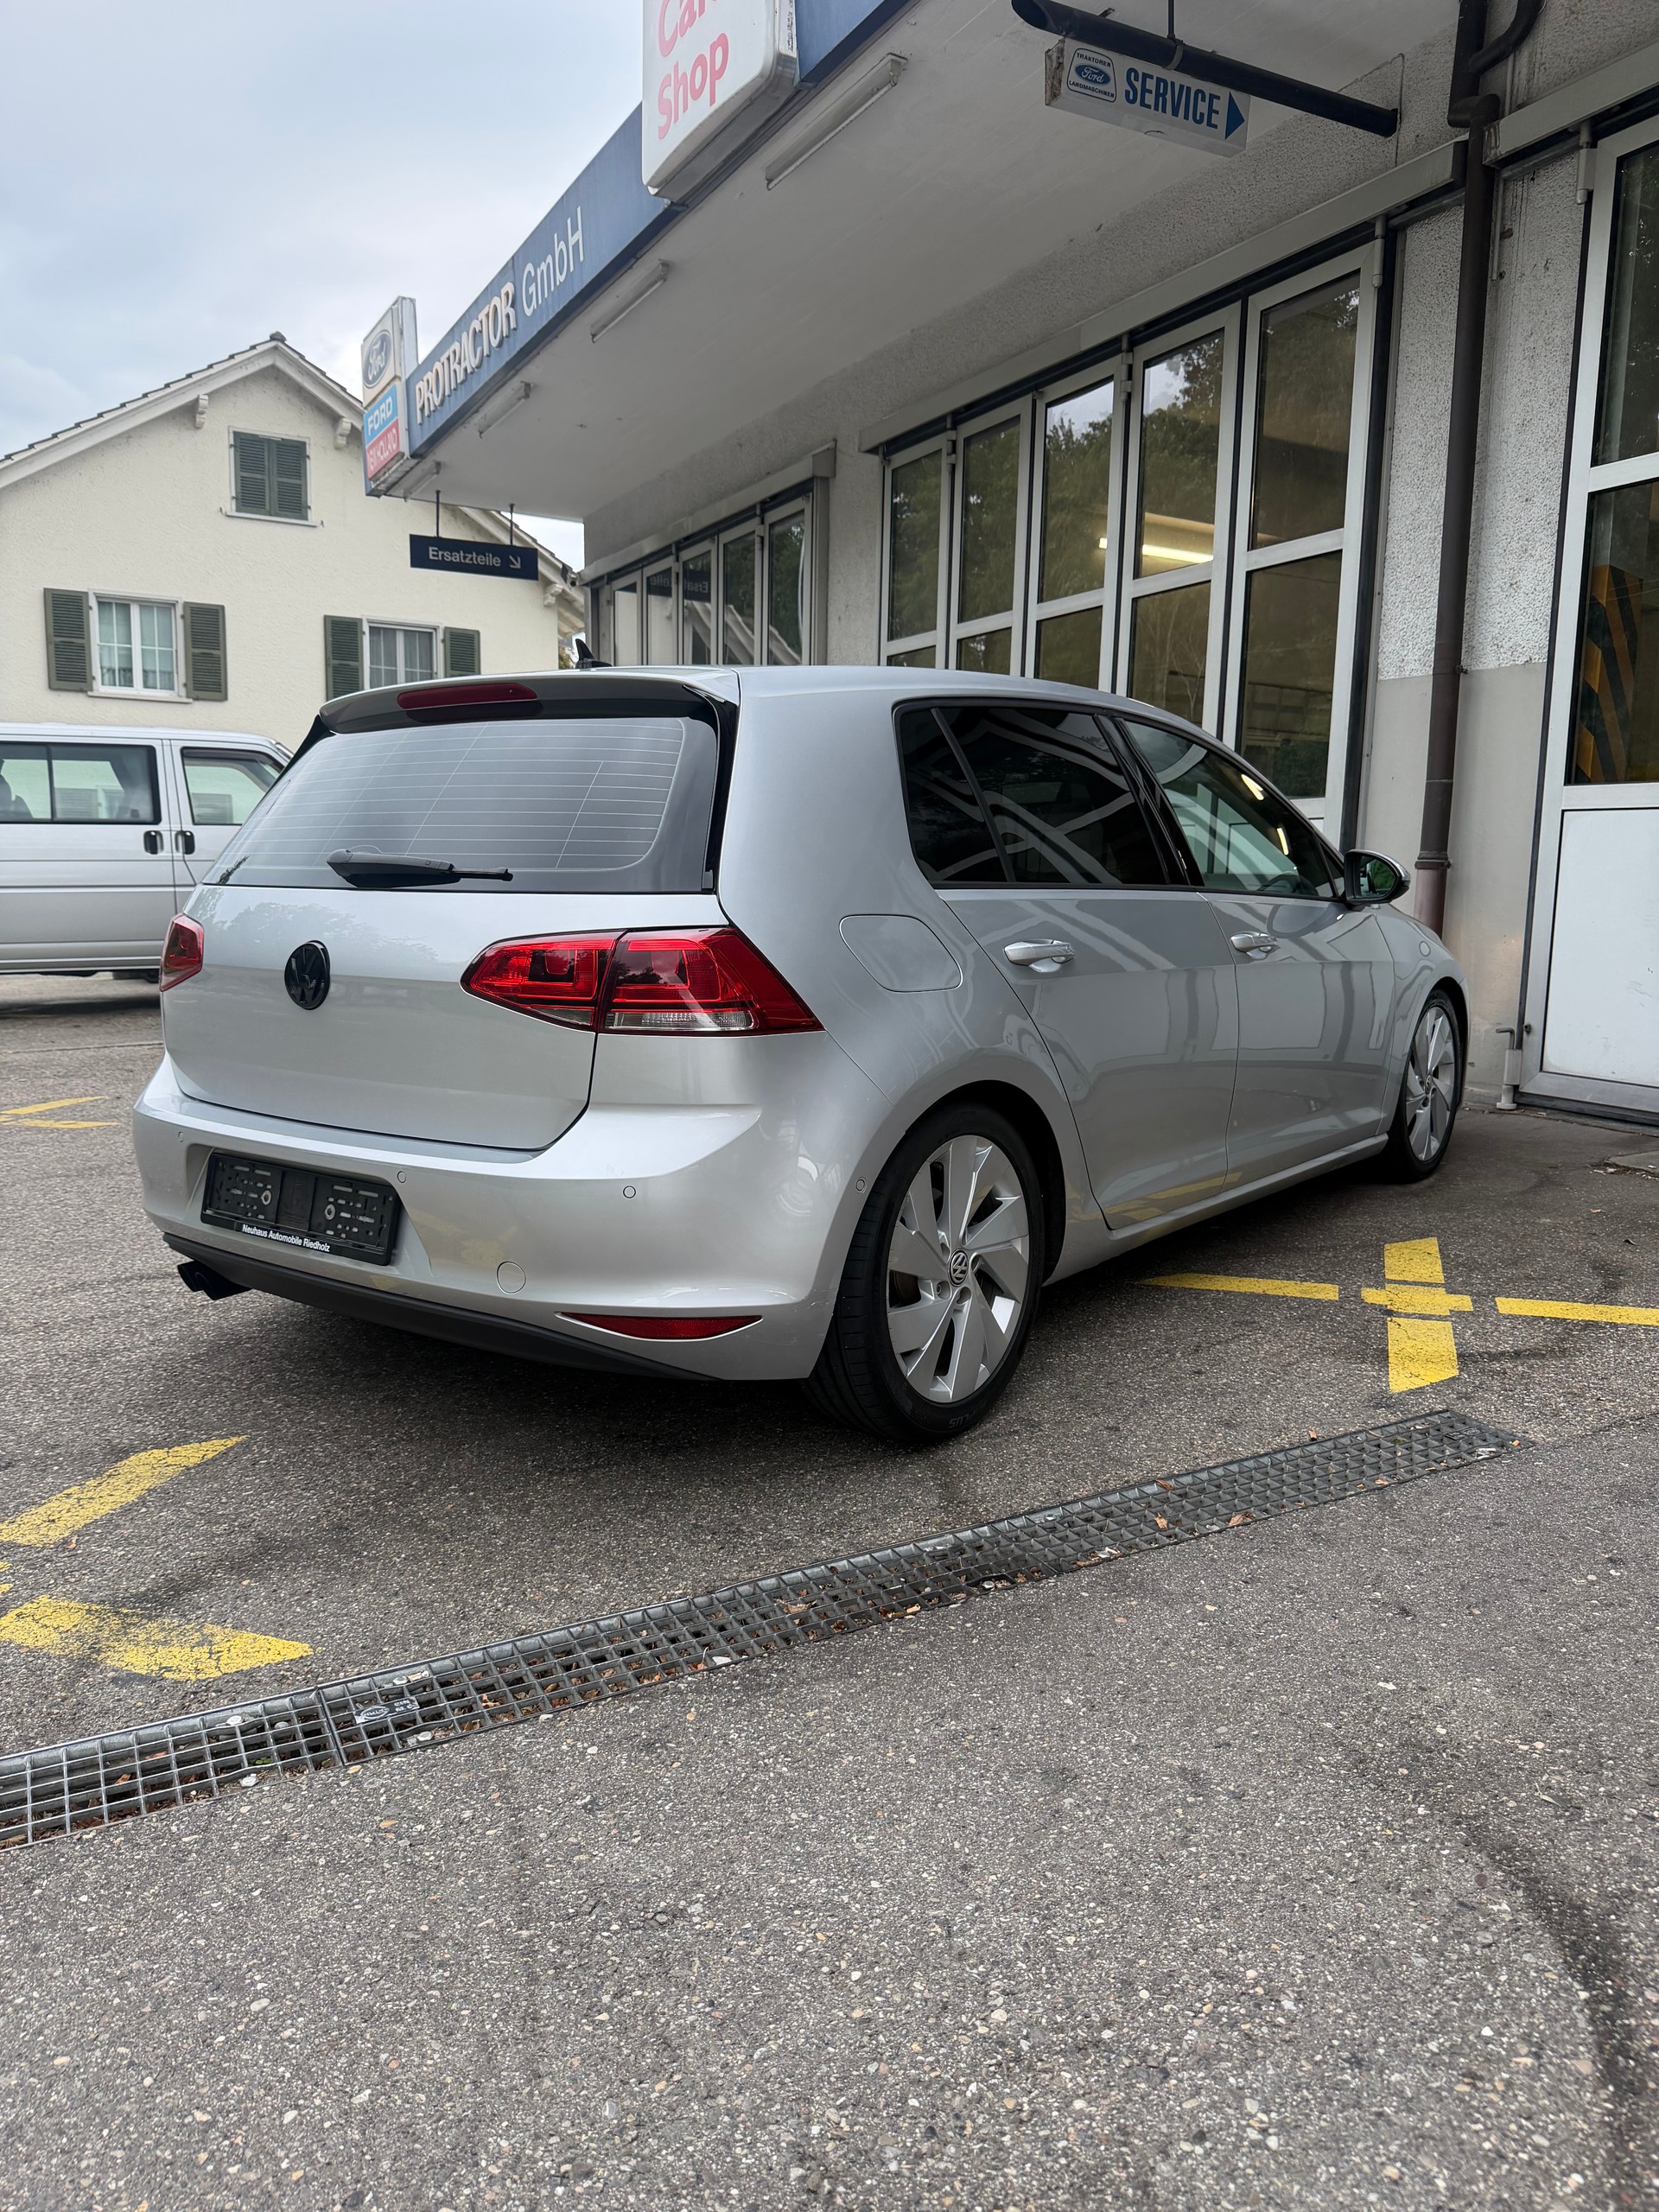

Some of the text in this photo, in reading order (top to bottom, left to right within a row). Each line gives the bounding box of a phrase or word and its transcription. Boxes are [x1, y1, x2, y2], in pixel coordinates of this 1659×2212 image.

[1077, 53, 1111, 67] TRAKTOREN
[1081, 67, 1104, 83] Ford
[658, 33, 728, 139] Shop
[1069, 80, 1115, 98] LANDMASCHINEN
[1125, 67, 1221, 129] SERVICE
[416, 206, 584, 425] PROTRACTOR GmbH
[368, 340, 386, 380] Ford
[367, 396, 393, 436] FORD
[429, 546, 501, 567] Ersatzteile
[243, 1224, 330, 1252] Neuhaus Automobile Riedholz
